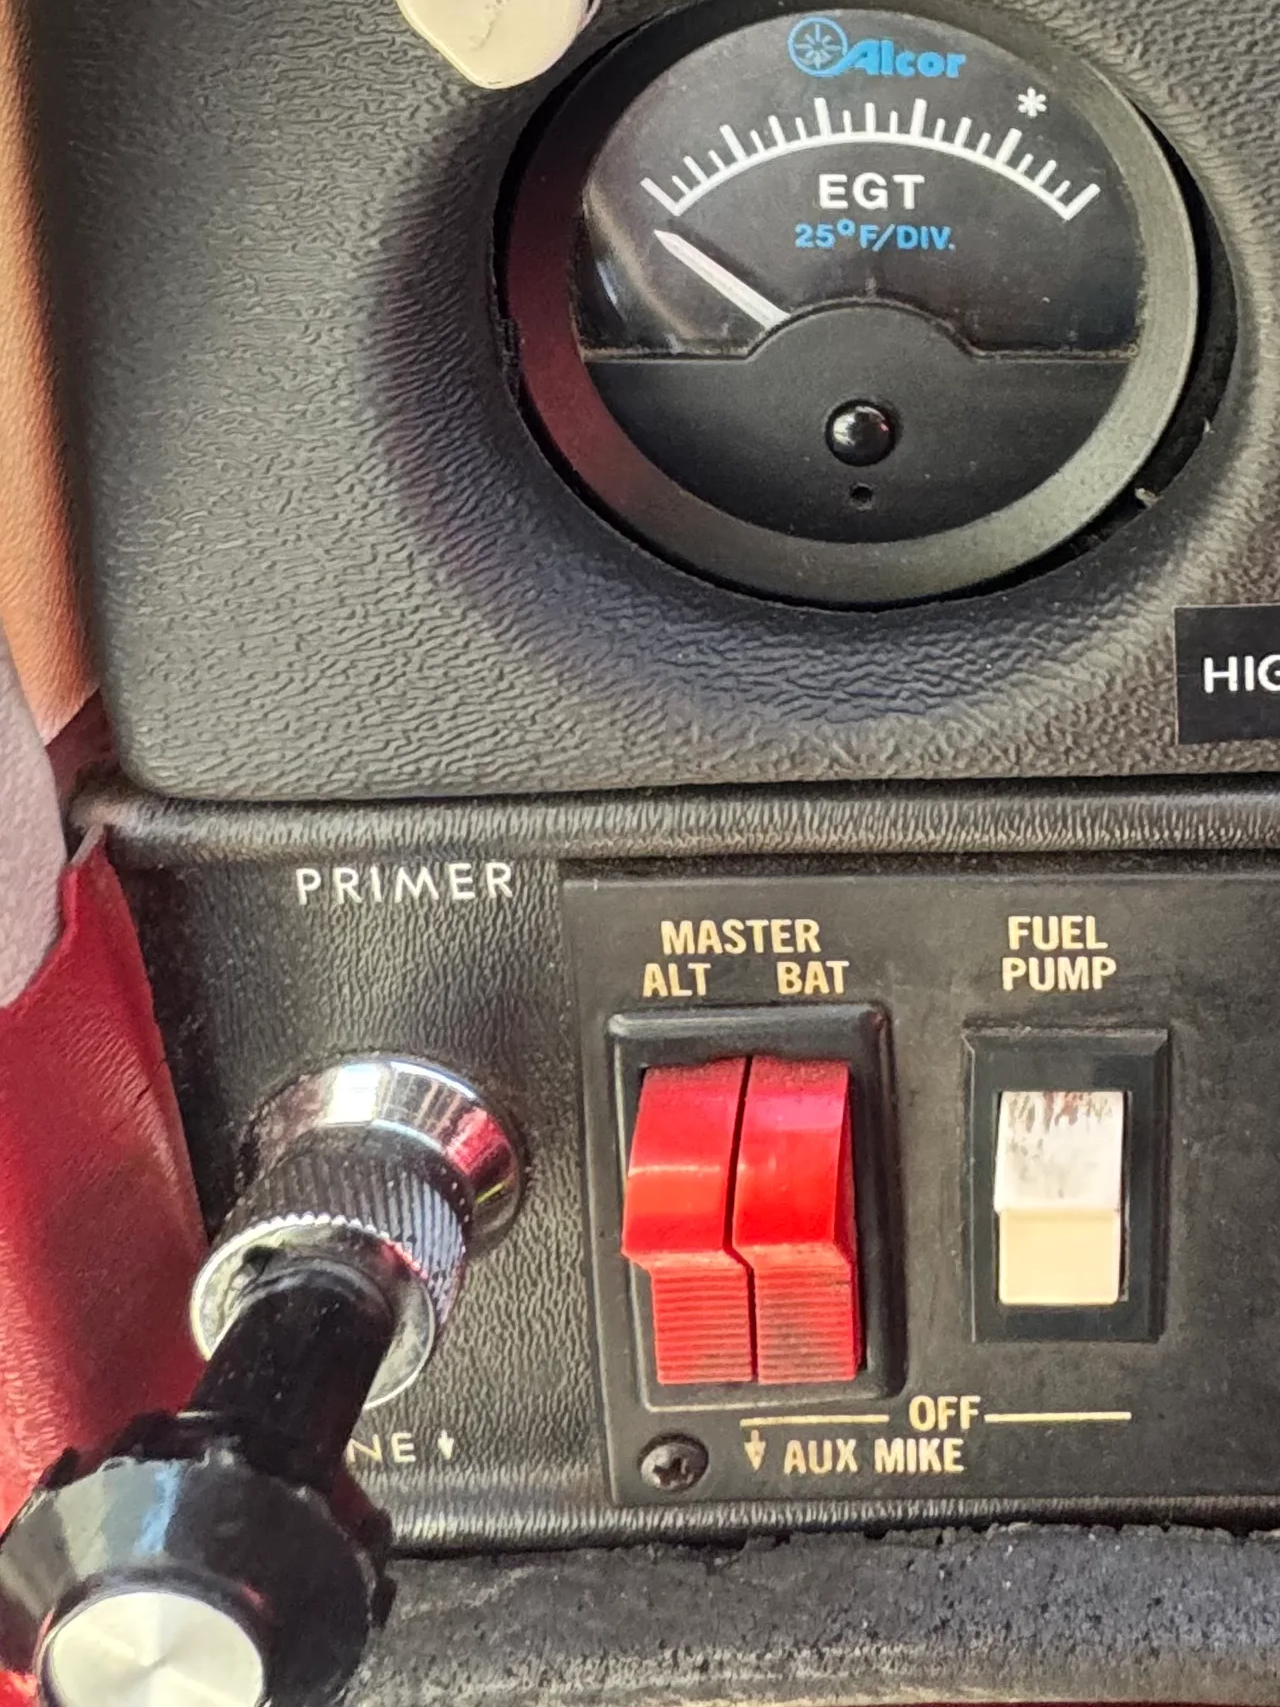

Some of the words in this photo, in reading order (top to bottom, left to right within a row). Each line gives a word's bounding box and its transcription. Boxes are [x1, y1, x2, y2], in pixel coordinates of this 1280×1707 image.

[833, 38, 967, 78] Alcor
[818, 172, 925, 210] EGT
[295, 862, 513, 906] PRIMER
[660, 919, 822, 955] MASTER
[1008, 915, 1109, 950] FUEL
[643, 962, 712, 998] ALT
[776, 960, 850, 996] BAT
[1002, 956, 1117, 992] PUMP
[909, 1394, 982, 1432] OFF
[783, 1438, 858, 1475] AUX
[874, 1437, 965, 1474] MIKE
